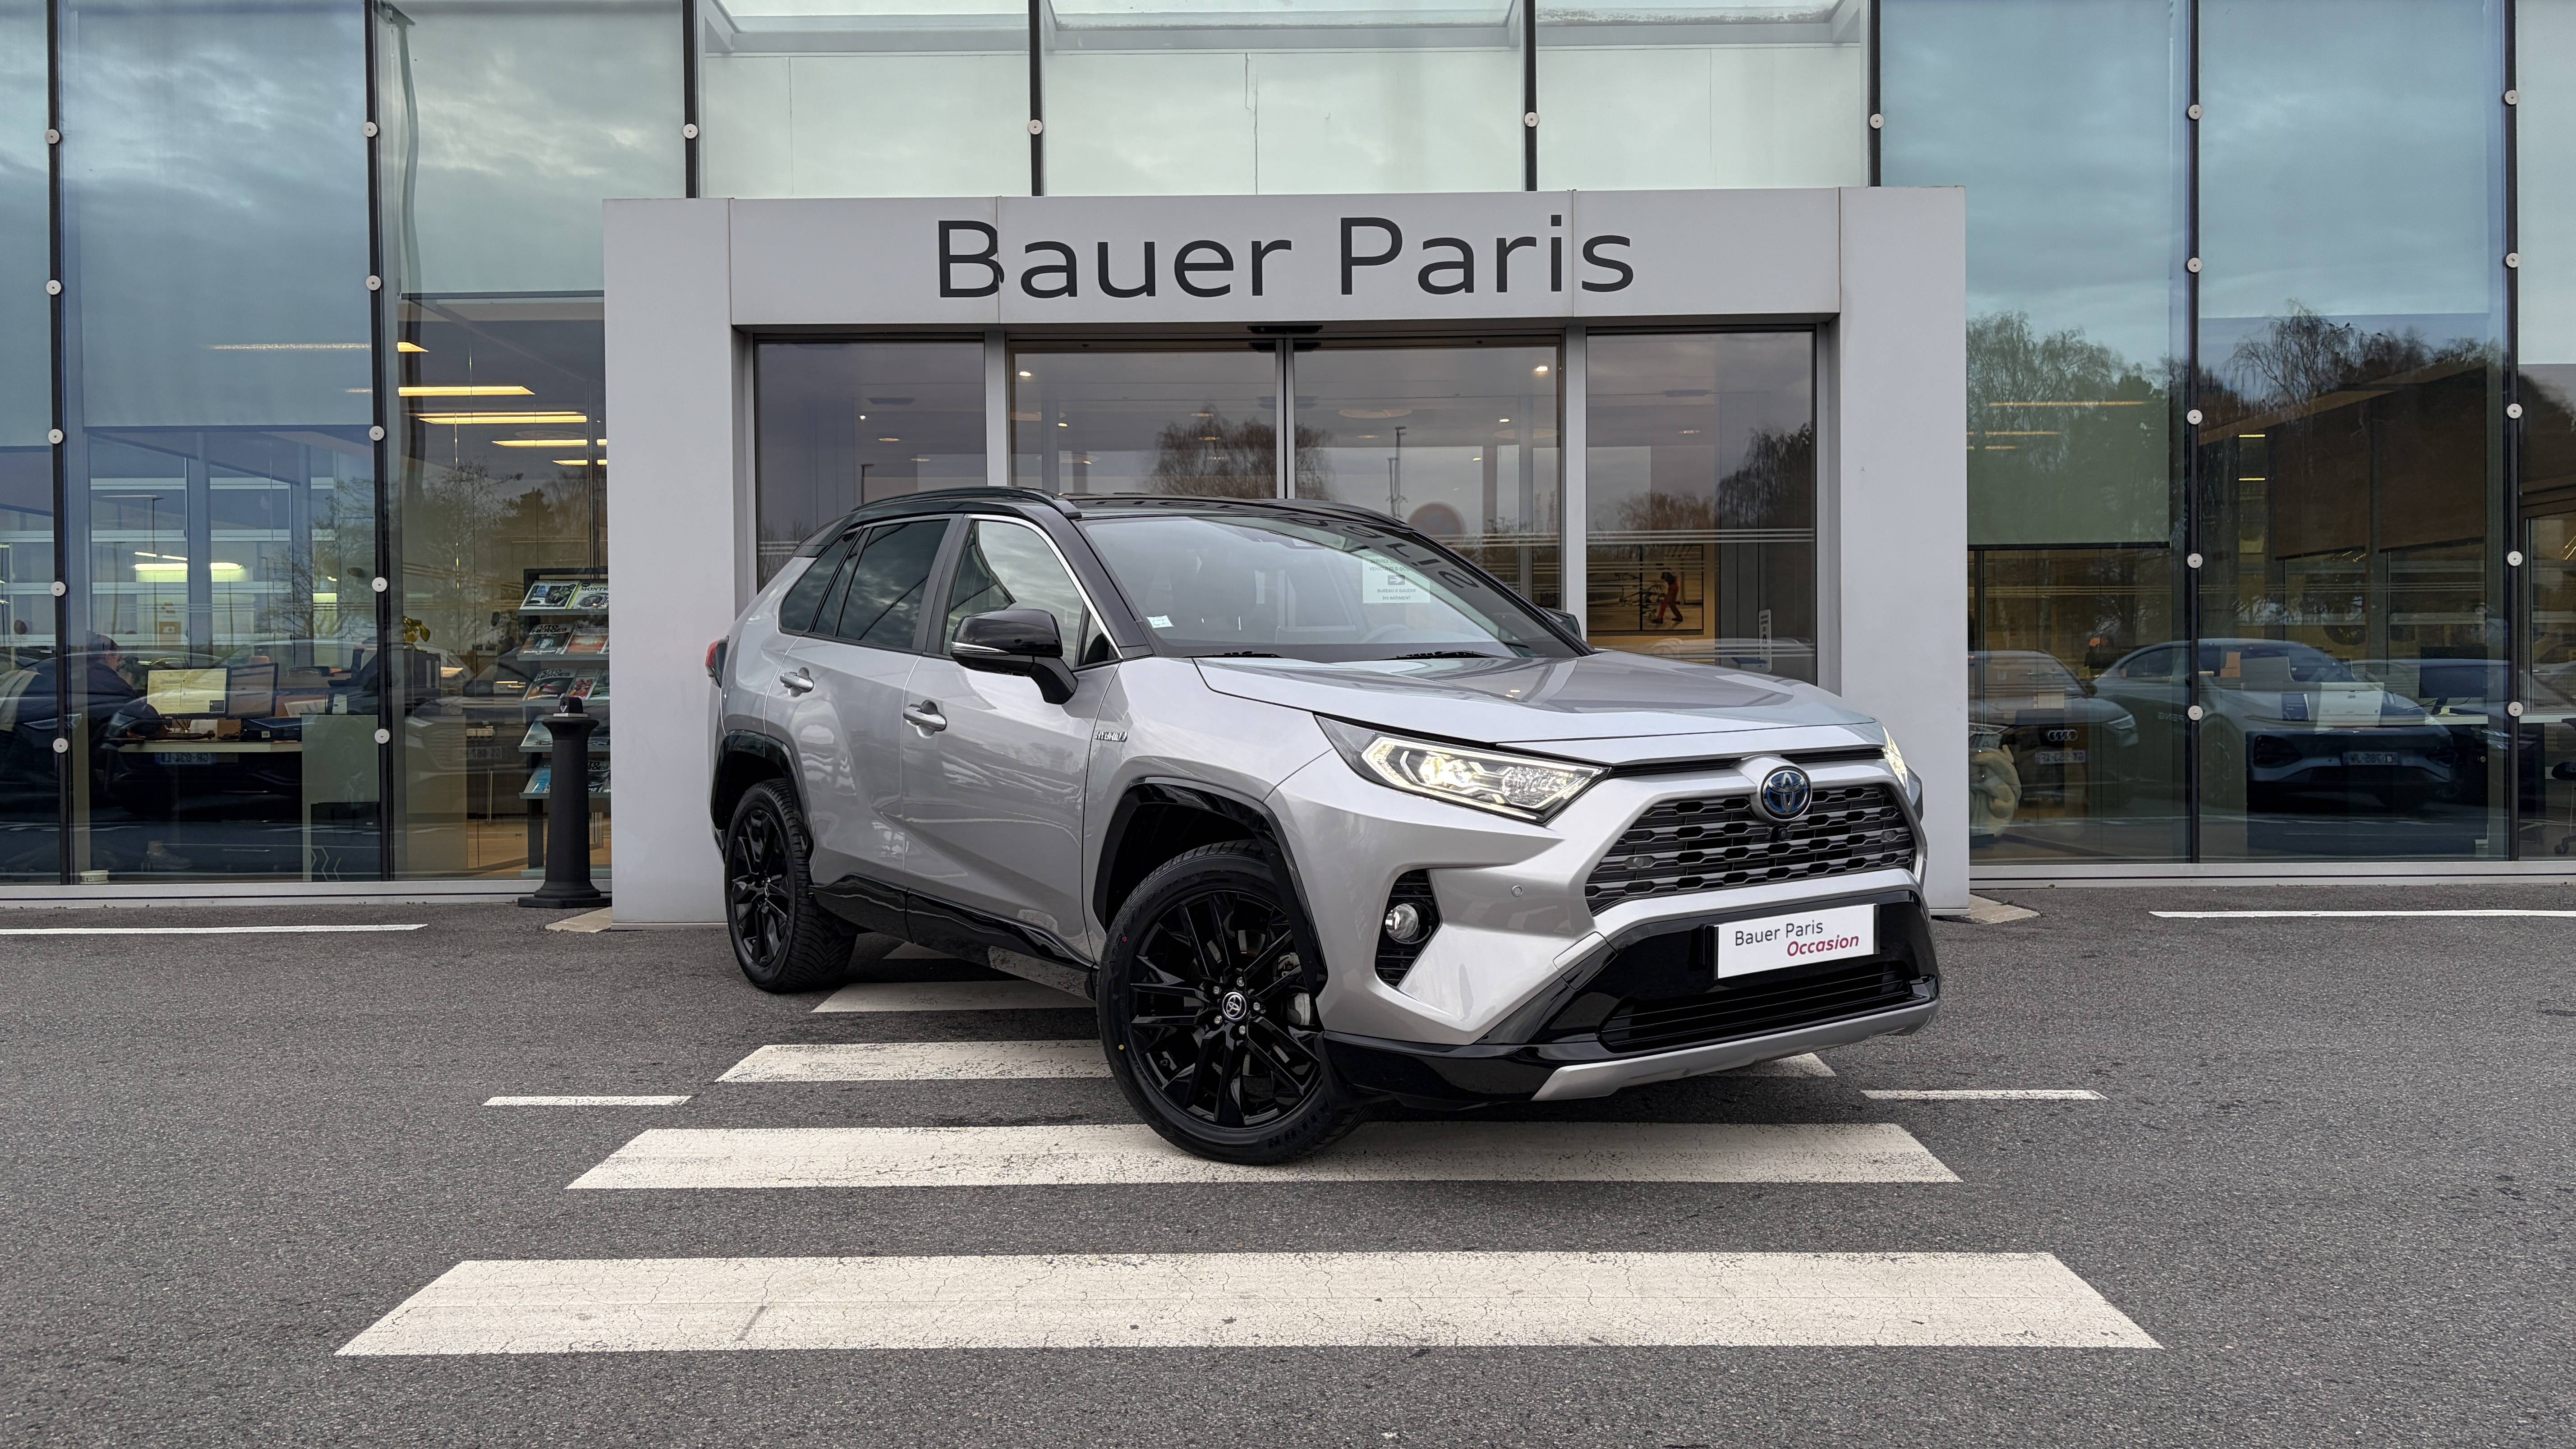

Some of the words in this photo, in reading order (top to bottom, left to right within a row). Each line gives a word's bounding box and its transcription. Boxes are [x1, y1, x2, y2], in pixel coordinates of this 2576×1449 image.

[938, 220, 1292, 299] Bauer
[1340, 214, 1633, 295] Paris
[1095, 731, 1123, 741] HYBRID
[1735, 928, 1780, 946] Bauer
[1786, 919, 1823, 938] Paris
[1787, 934, 1859, 957] Occasion
